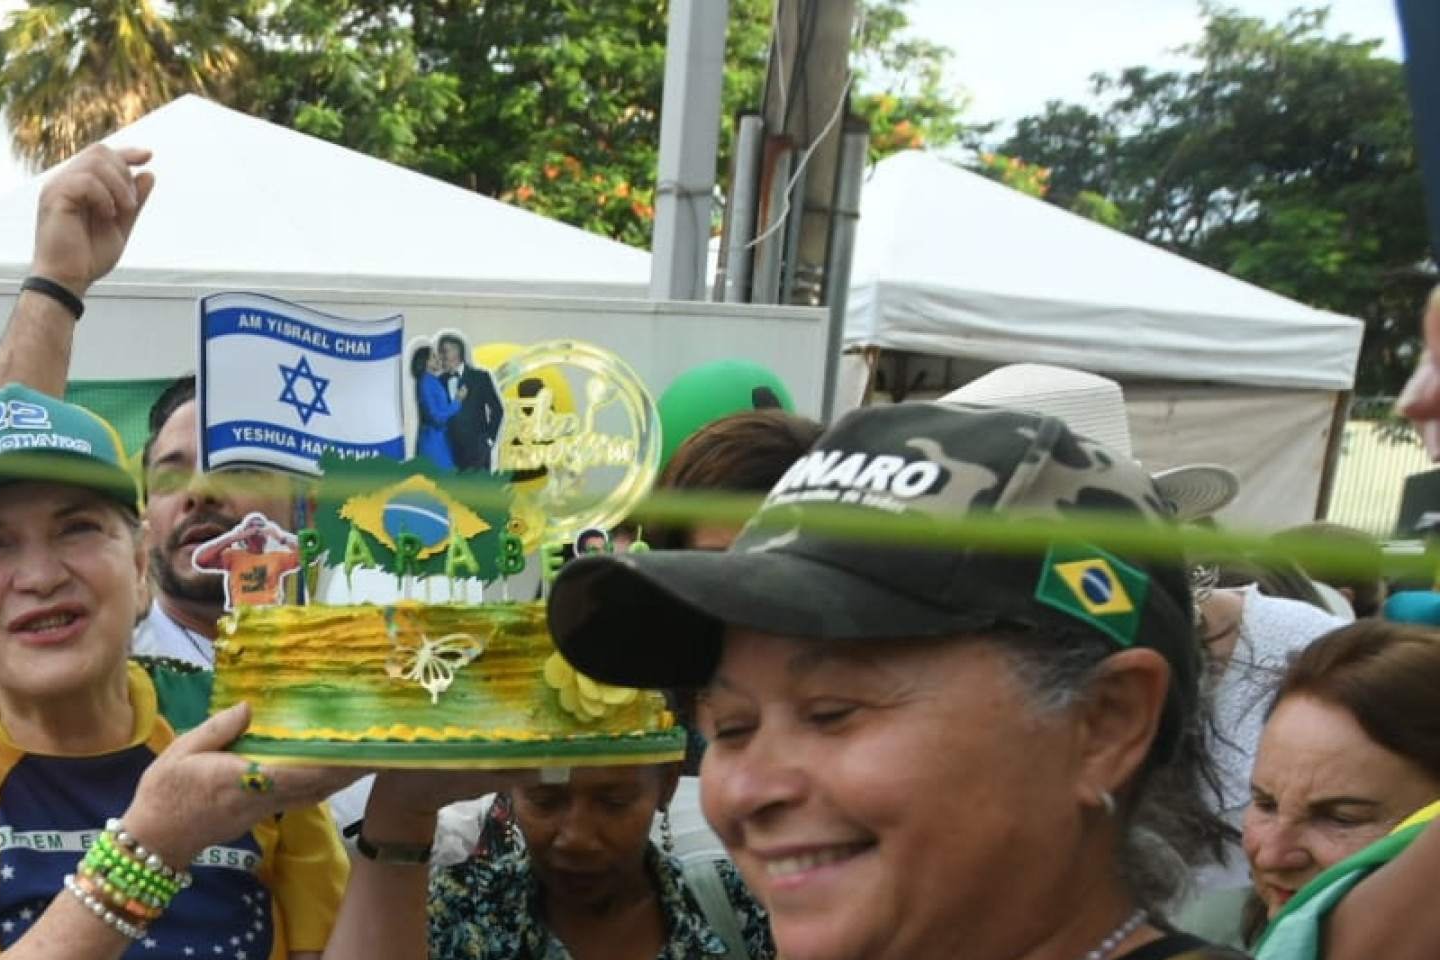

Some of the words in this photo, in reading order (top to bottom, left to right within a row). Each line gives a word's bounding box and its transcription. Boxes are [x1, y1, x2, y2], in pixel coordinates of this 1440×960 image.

[238, 314, 263, 329] AM
[335, 338, 371, 355] CHAI
[232, 427, 296, 448] YESHUA
